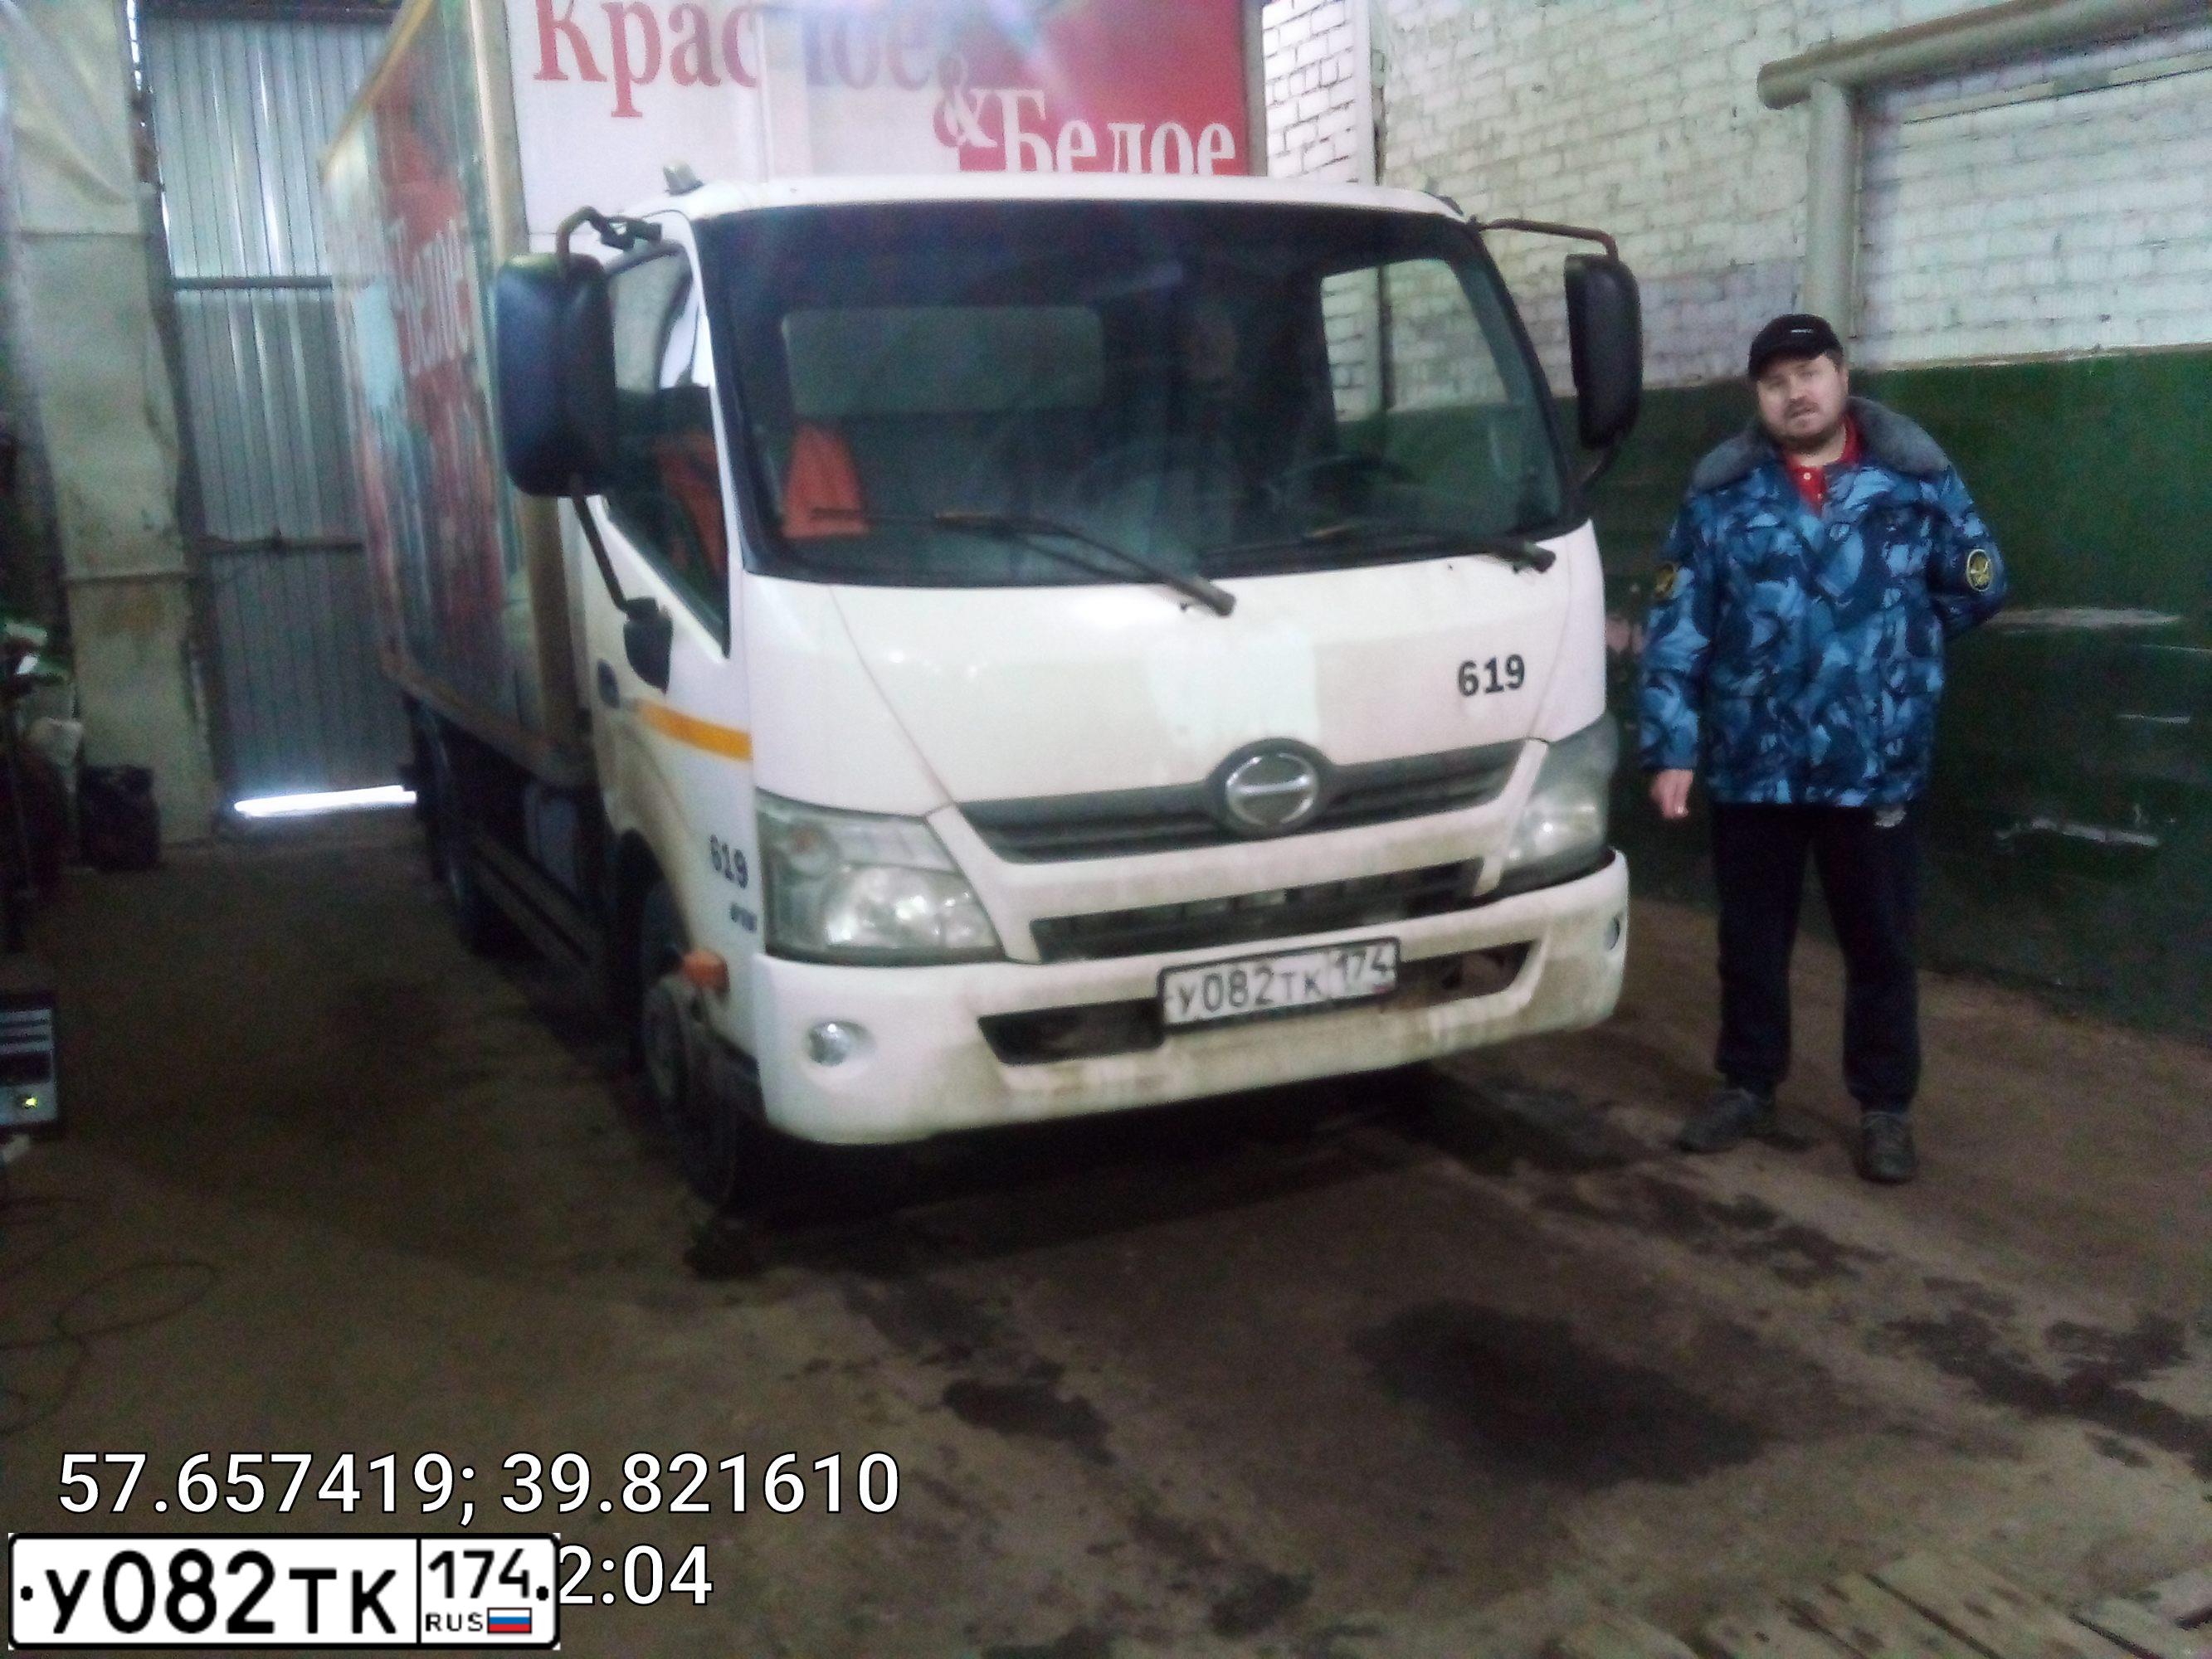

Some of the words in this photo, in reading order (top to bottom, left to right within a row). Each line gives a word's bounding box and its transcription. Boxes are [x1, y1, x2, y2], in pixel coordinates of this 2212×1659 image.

[996, 89, 1236, 176] Белое
[1458, 654, 1525, 697] 619
[709, 834, 749, 889] 619
